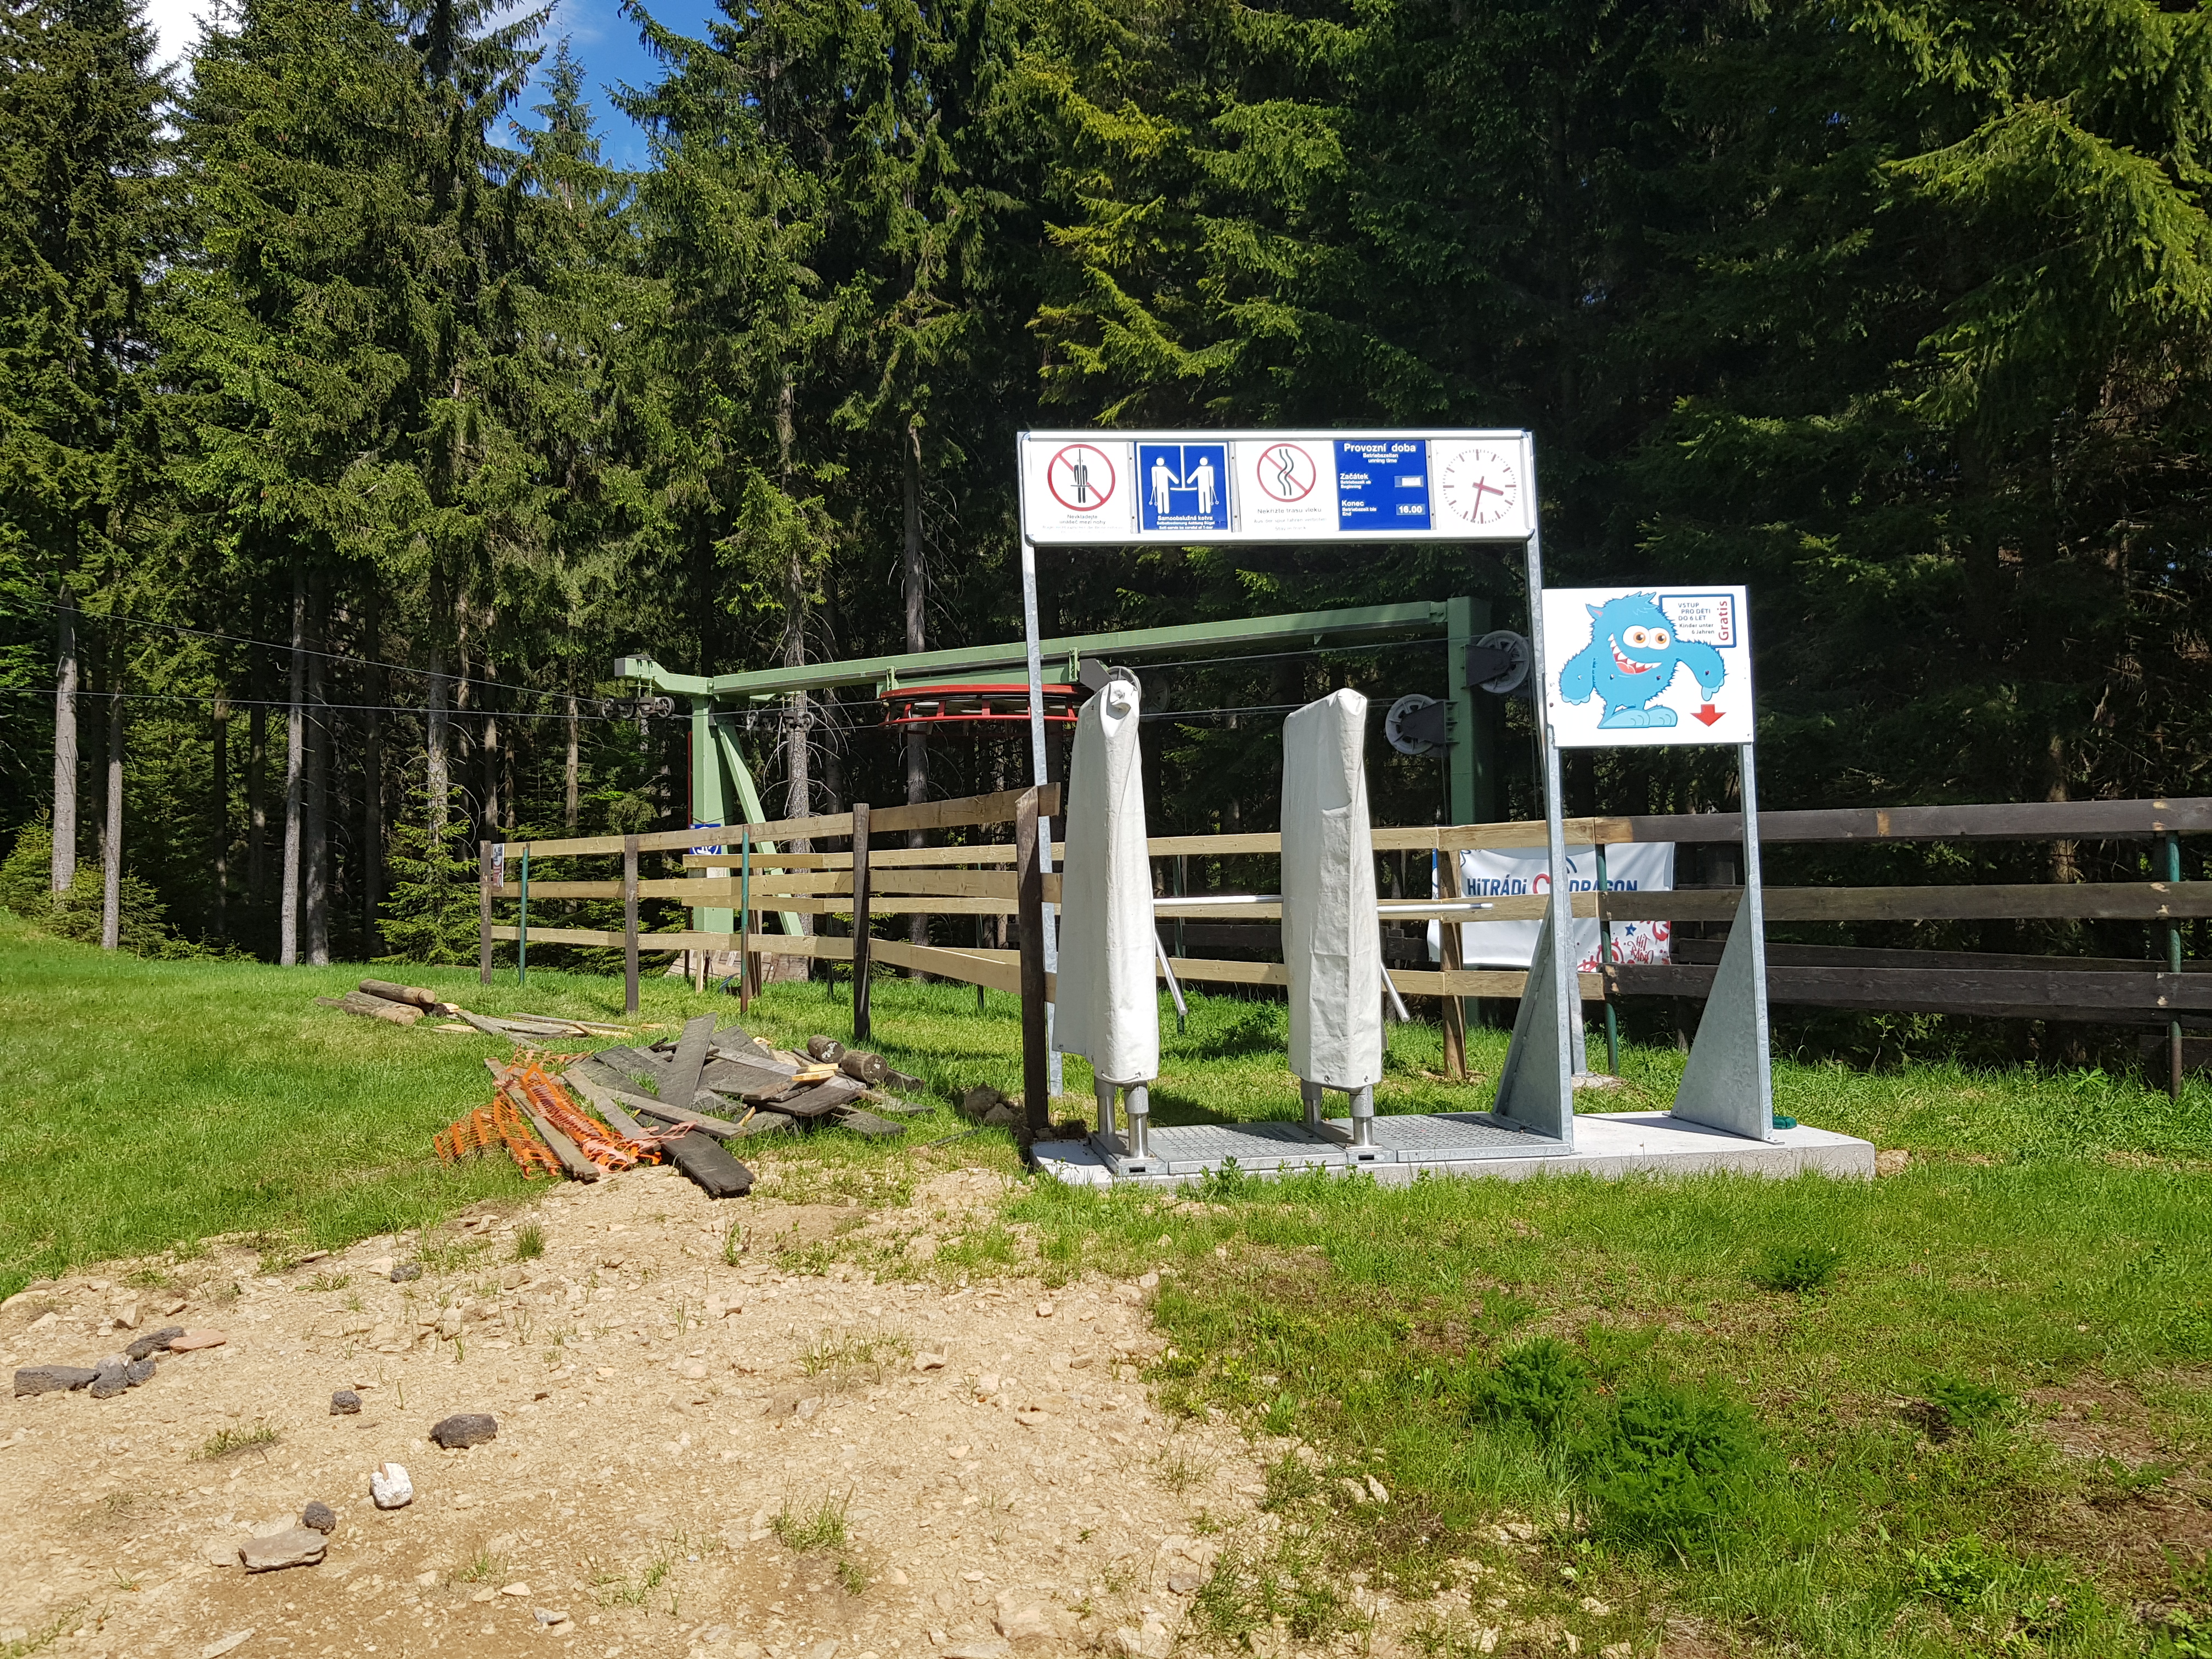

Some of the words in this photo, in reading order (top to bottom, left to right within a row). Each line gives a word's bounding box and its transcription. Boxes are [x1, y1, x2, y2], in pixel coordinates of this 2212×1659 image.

[1344, 443, 1387, 452] Provozní
[1391, 443, 1416, 452] doba
[1398, 505, 1423, 514] 16.00
[1717, 601, 1729, 641] Gratis
